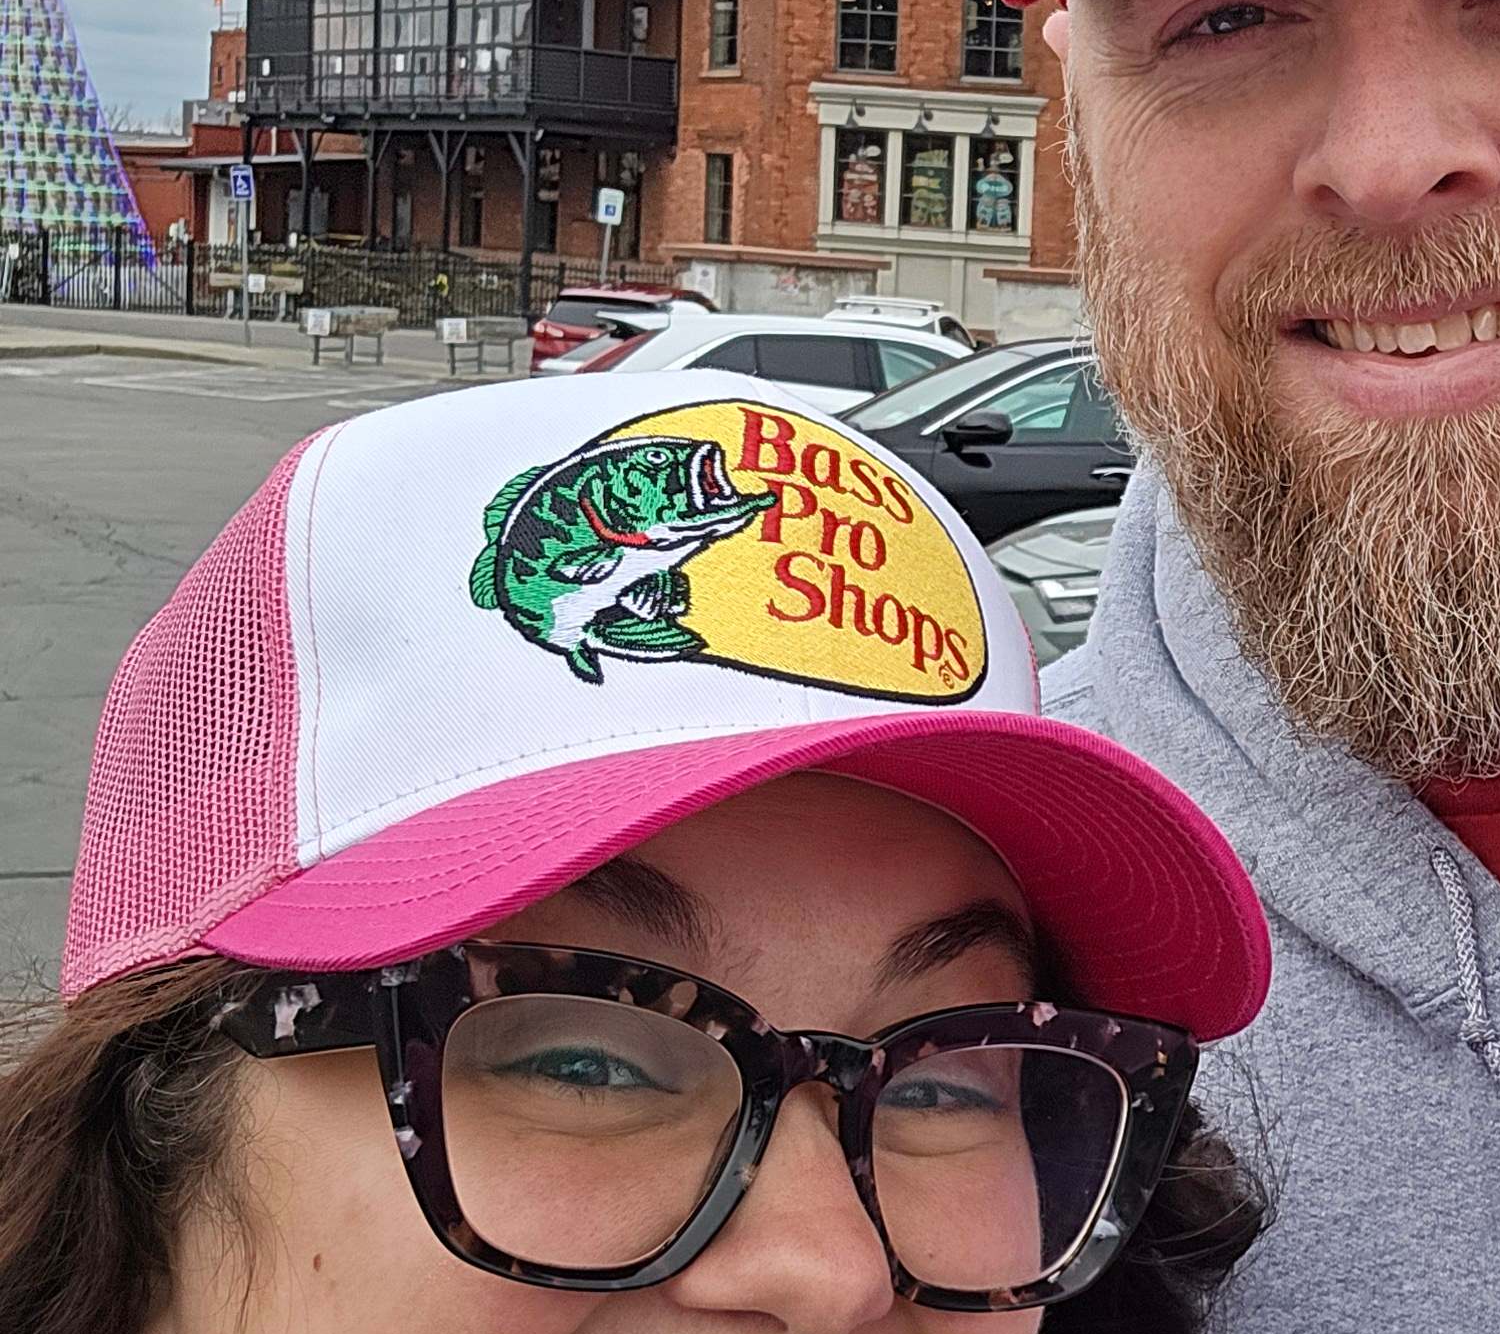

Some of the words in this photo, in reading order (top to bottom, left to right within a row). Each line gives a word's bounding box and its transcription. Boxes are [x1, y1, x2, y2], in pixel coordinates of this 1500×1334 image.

[732, 406, 914, 524] Bass
[757, 477, 886, 571] Pro
[766, 550, 970, 681] Shops
